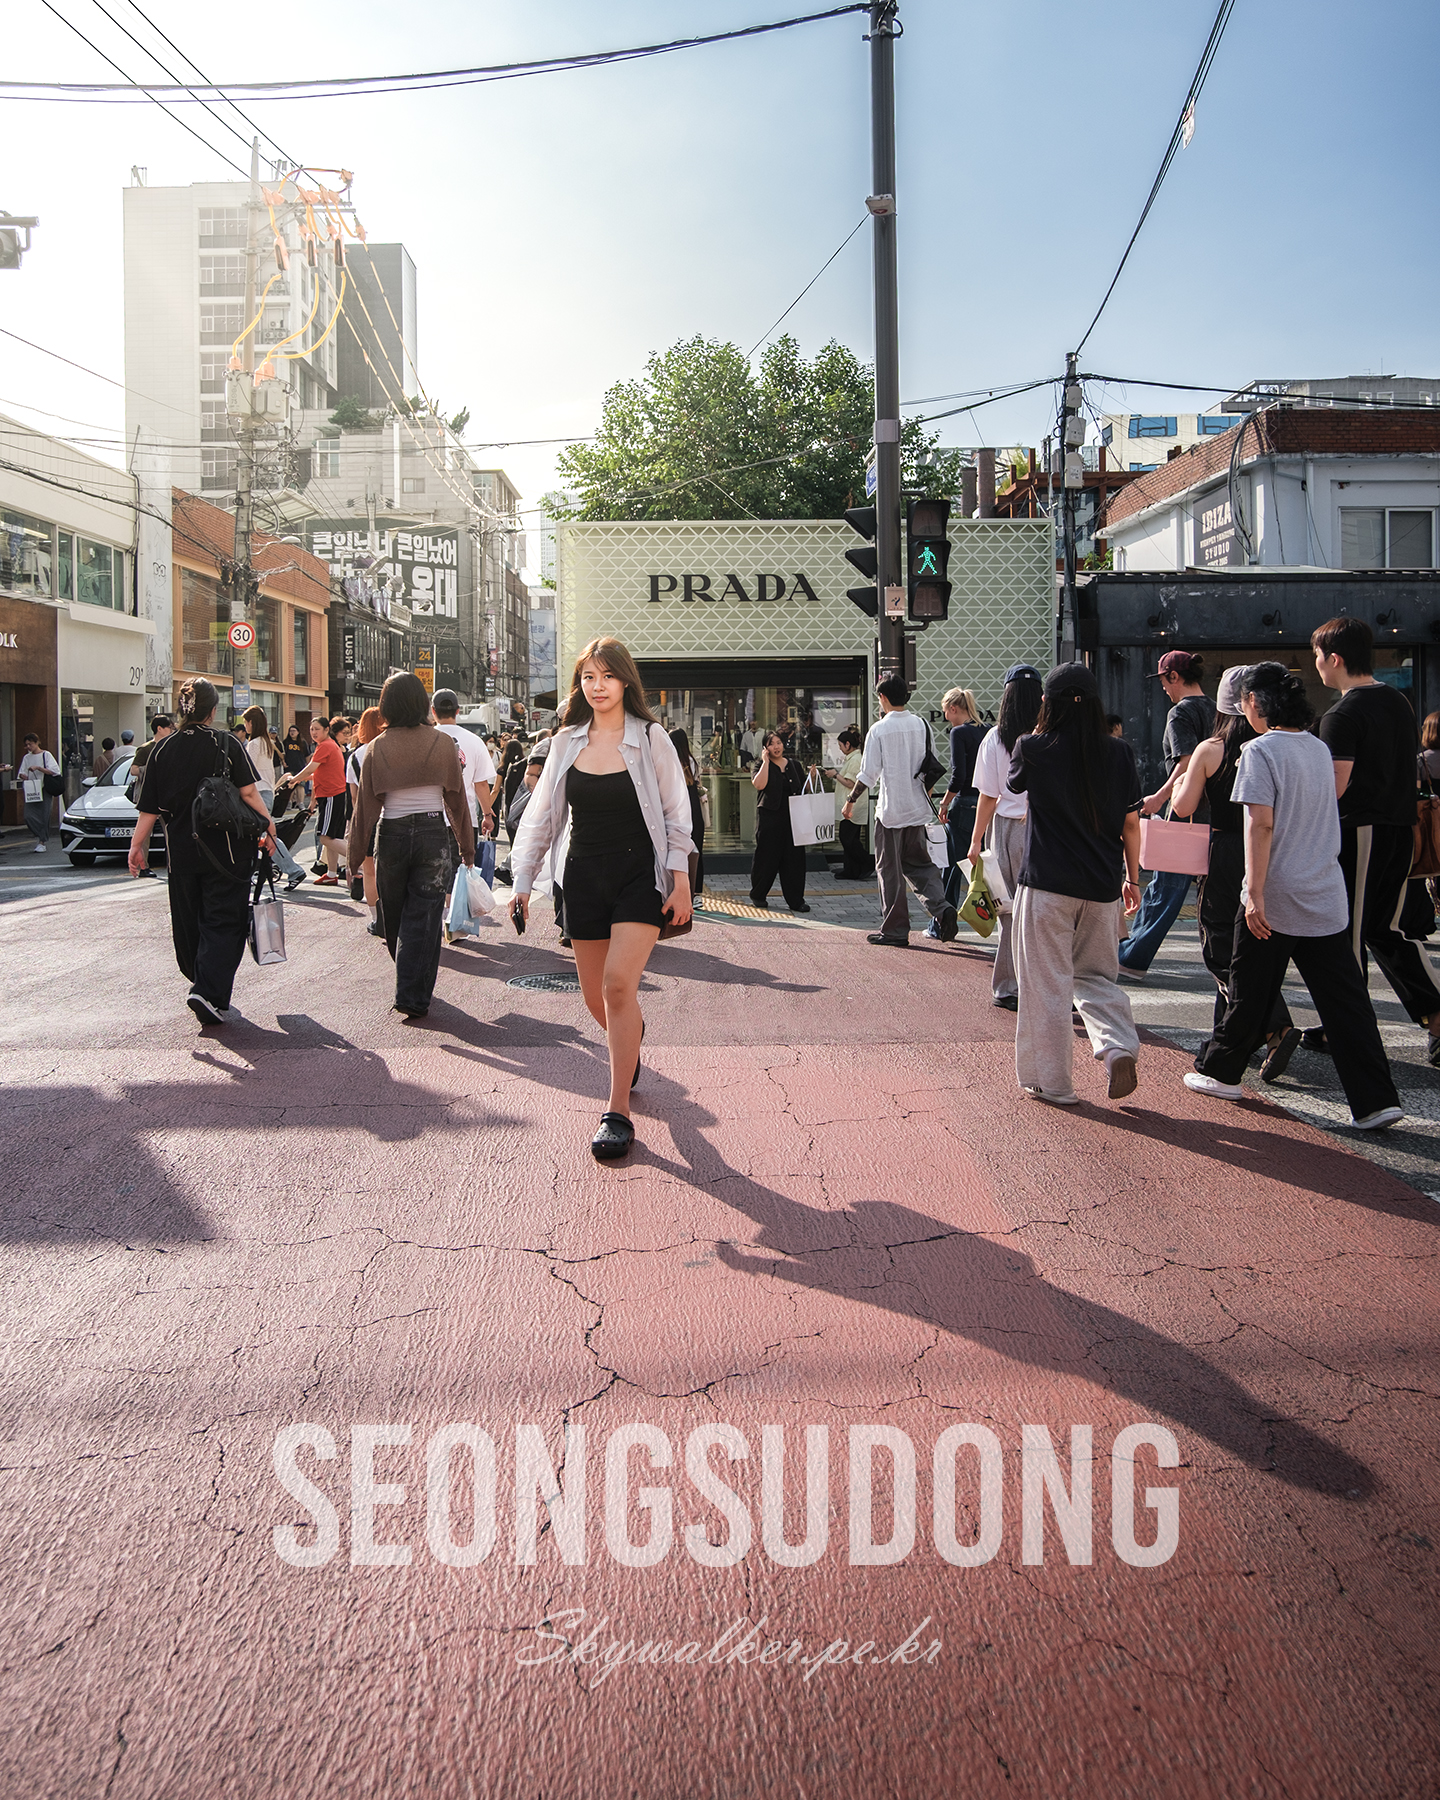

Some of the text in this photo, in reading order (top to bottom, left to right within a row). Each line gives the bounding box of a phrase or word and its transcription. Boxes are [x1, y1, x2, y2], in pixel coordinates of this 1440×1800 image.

[1202, 501, 1232, 534] IBIZA
[398, 532, 457, 566] 큰일났어
[1205, 541, 1230, 560] STUDIO
[647, 573, 820, 602] PRADA
[233, 629, 250, 642] 30
[345, 635, 353, 664] LUSH
[418, 651, 431, 660] 24
[929, 710, 997, 722] PDA
